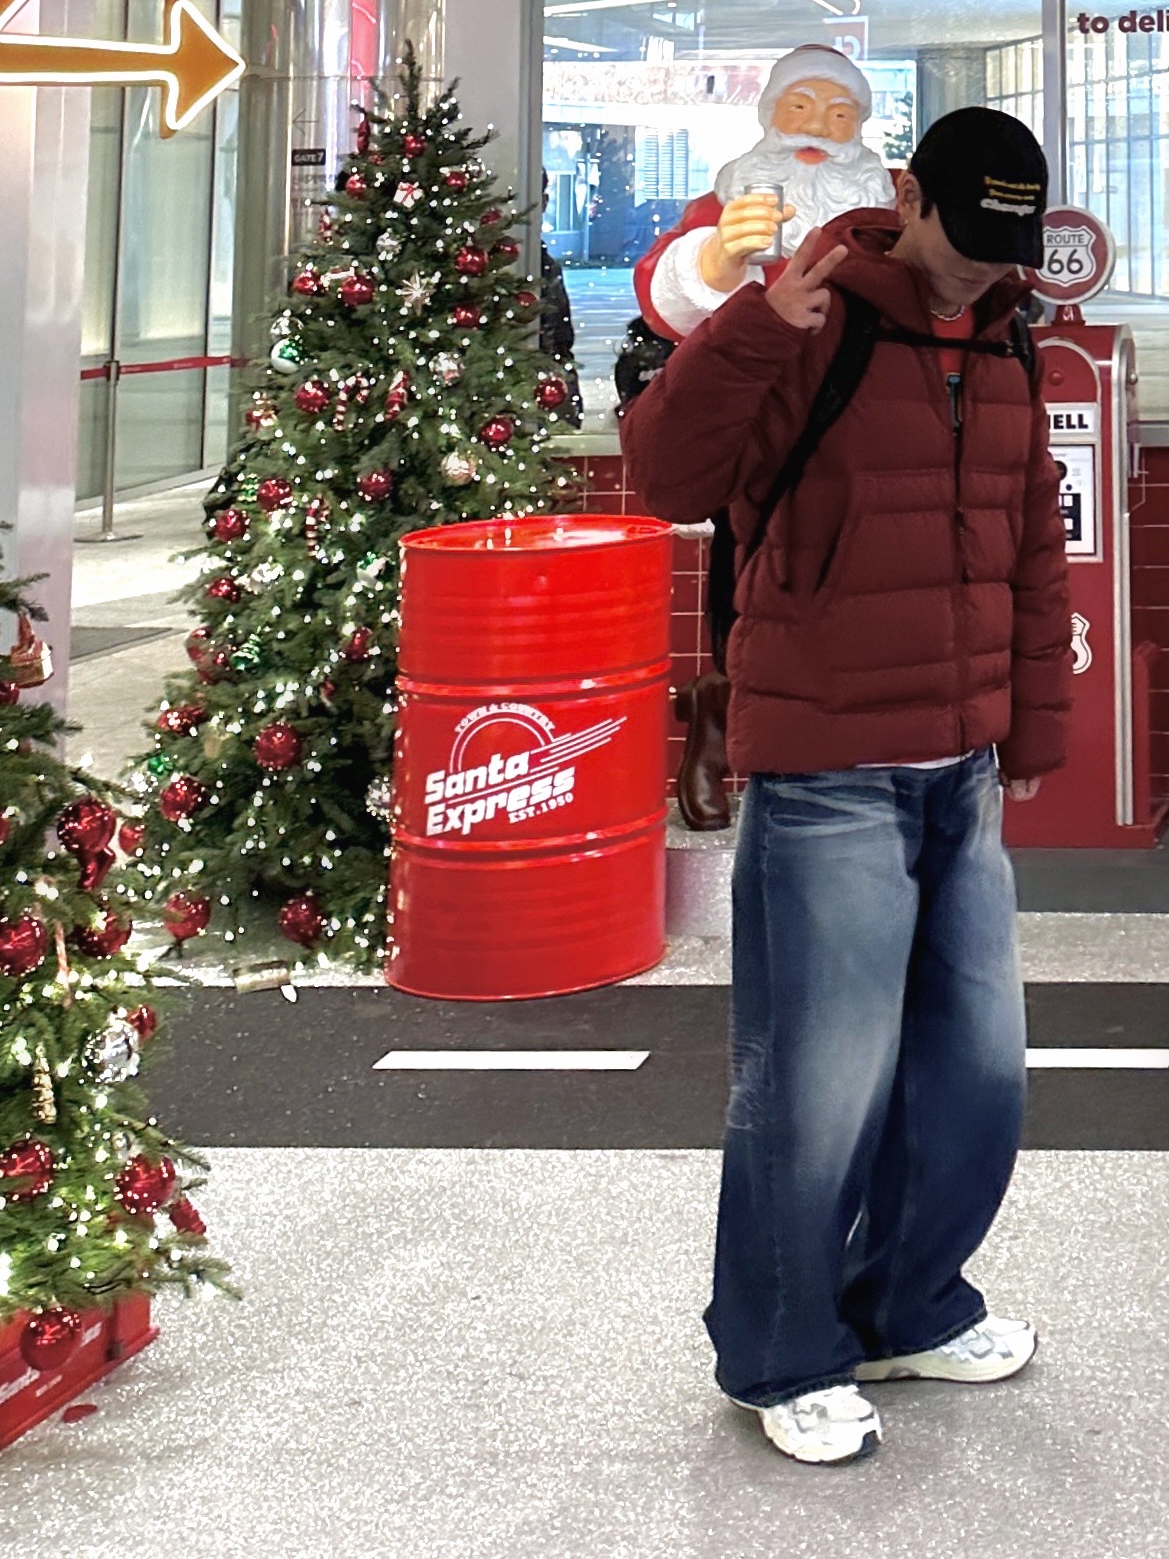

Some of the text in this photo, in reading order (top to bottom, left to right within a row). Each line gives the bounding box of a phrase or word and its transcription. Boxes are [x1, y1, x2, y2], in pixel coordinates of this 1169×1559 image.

[1077, 13, 1109, 34] to
[1046, 233, 1085, 245] ROUTE
[1047, 248, 1084, 275] 66
[1048, 414, 1088, 430] ELL
[425, 751, 530, 804] Santa
[426, 766, 576, 835] Express
